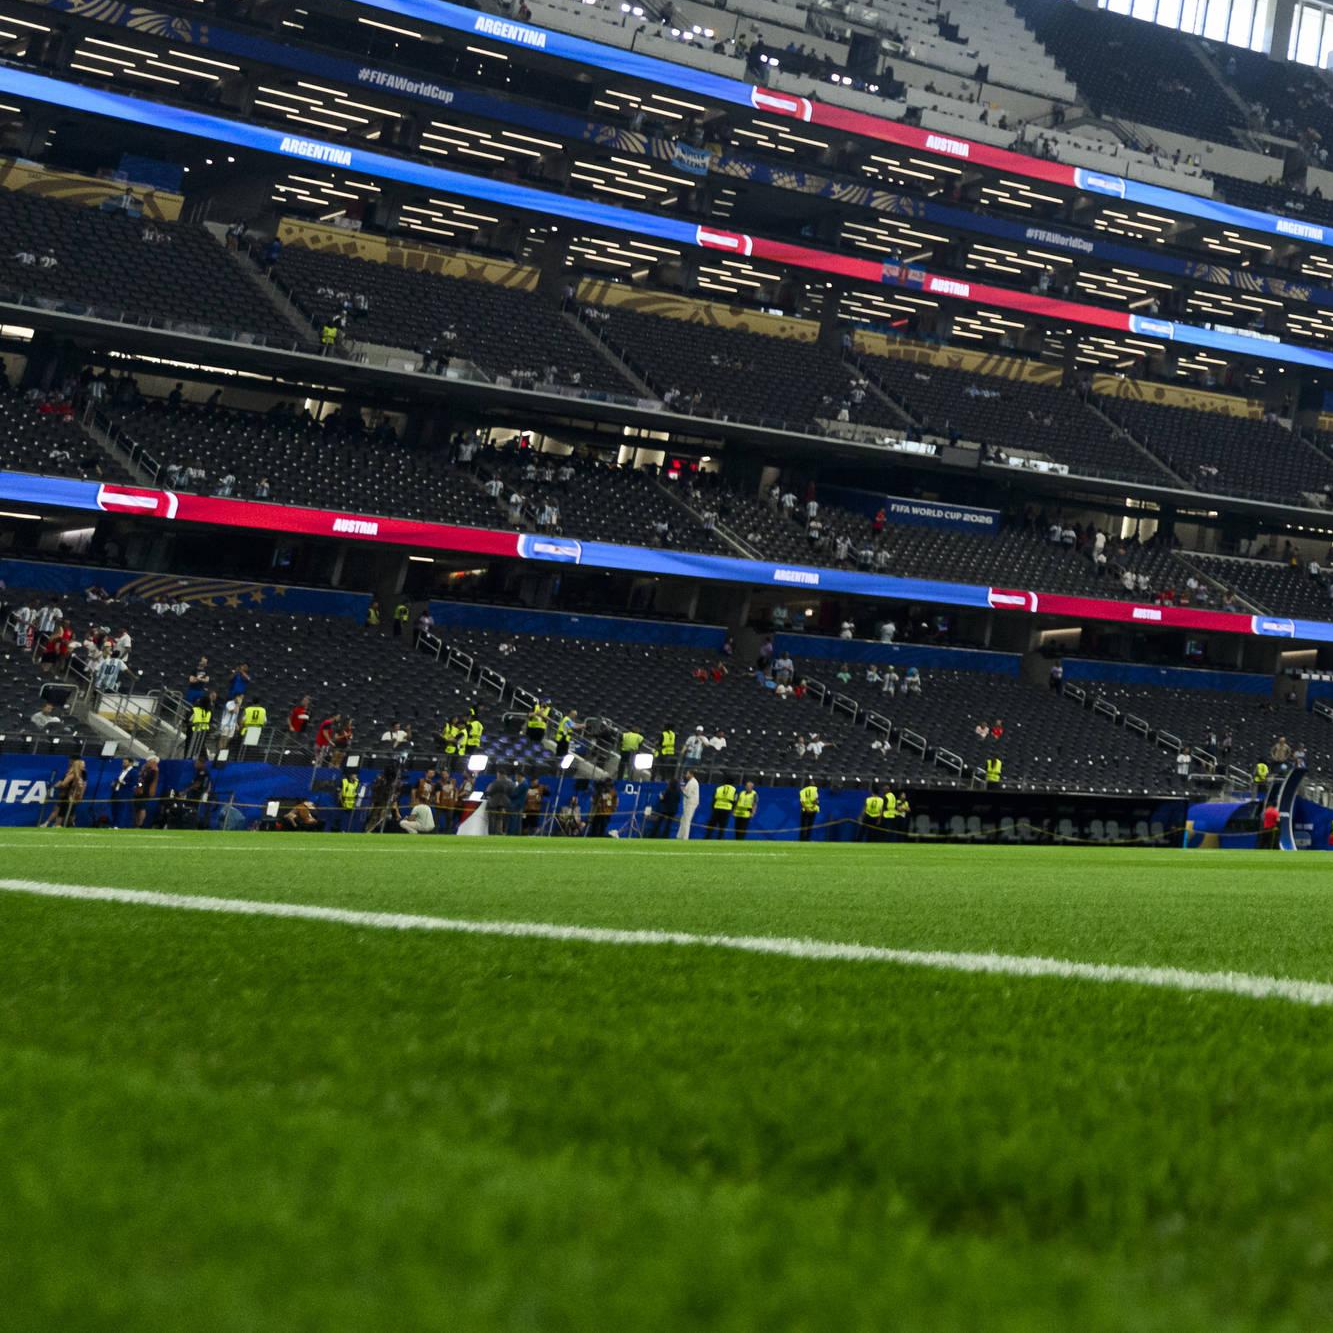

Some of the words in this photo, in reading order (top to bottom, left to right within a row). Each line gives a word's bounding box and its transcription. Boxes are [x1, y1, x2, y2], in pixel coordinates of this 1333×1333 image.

[475, 15, 547, 48] ARGENTINA
[357, 67, 455, 104] #FIFAWorldCup
[279, 137, 352, 167] ARGENTINA
[926, 135, 969, 157] AUSTRIA
[1026, 228, 1094, 253] #FIFAWorldCup
[1276, 219, 1323, 241] ARGENTINA
[930, 278, 969, 297] AUSTRIA
[890, 503, 910, 514] FIFA
[911, 507, 943, 519] WORLD
[944, 510, 962, 520] CUP
[962, 513, 993, 524] 2026
[332, 518, 378, 536] AUSTRIA
[773, 569, 819, 585] ARGENTINA
[0, 779, 48, 804] IFA
